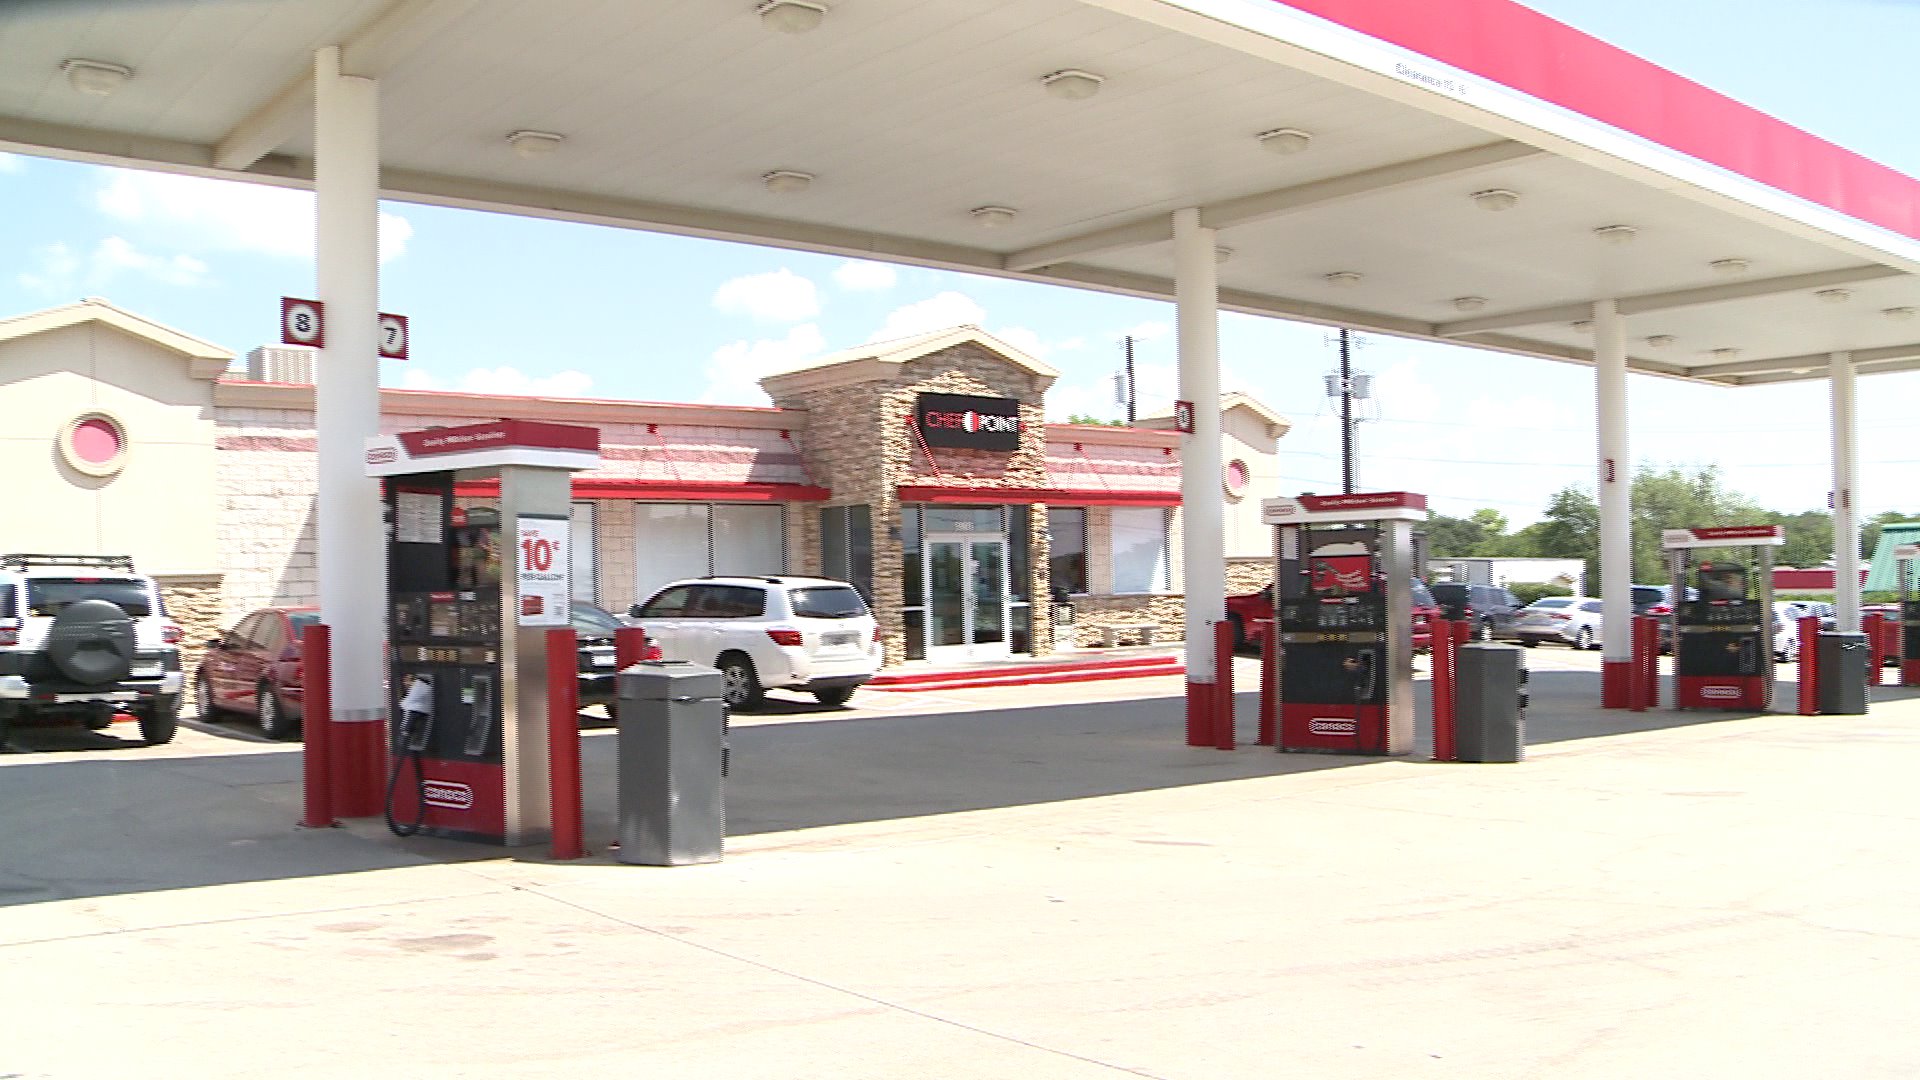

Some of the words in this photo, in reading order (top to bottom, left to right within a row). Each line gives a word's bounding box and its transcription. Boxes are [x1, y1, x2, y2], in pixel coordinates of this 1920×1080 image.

[1395, 63, 1443, 88] Clearance
[295, 313, 311, 332] 8
[383, 326, 397, 345] 7
[925, 411, 963, 429] CHEF
[978, 414, 1019, 432] POINT
[520, 529, 539, 537] SAVE
